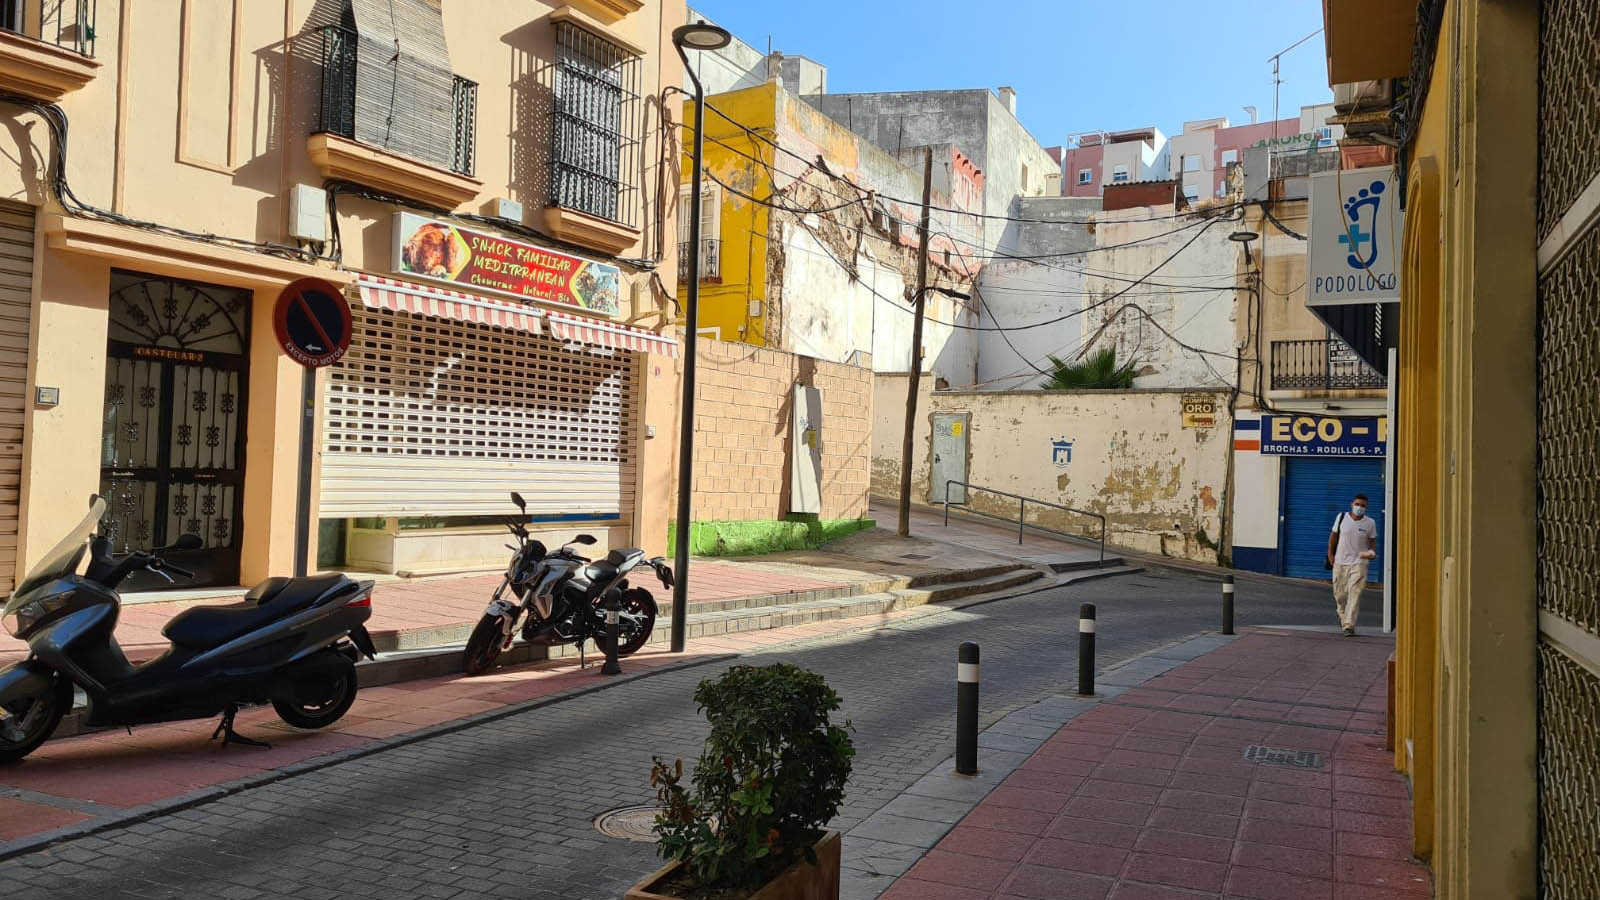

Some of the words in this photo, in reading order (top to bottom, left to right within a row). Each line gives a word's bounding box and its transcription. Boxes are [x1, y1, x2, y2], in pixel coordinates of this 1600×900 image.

[472, 236, 512, 258] SNACK
[516, 248, 571, 272] FAMILIAR
[557, 292, 570, 303] Bio
[285, 342, 318, 366] EXCEPTO
[320, 347, 344, 365] MOTOS
[1185, 403, 1212, 413] ORO
[1271, 416, 1343, 442] ECO
[1263, 445, 1308, 454] BROCHAS
[1316, 446, 1366, 455] RODILLOS
